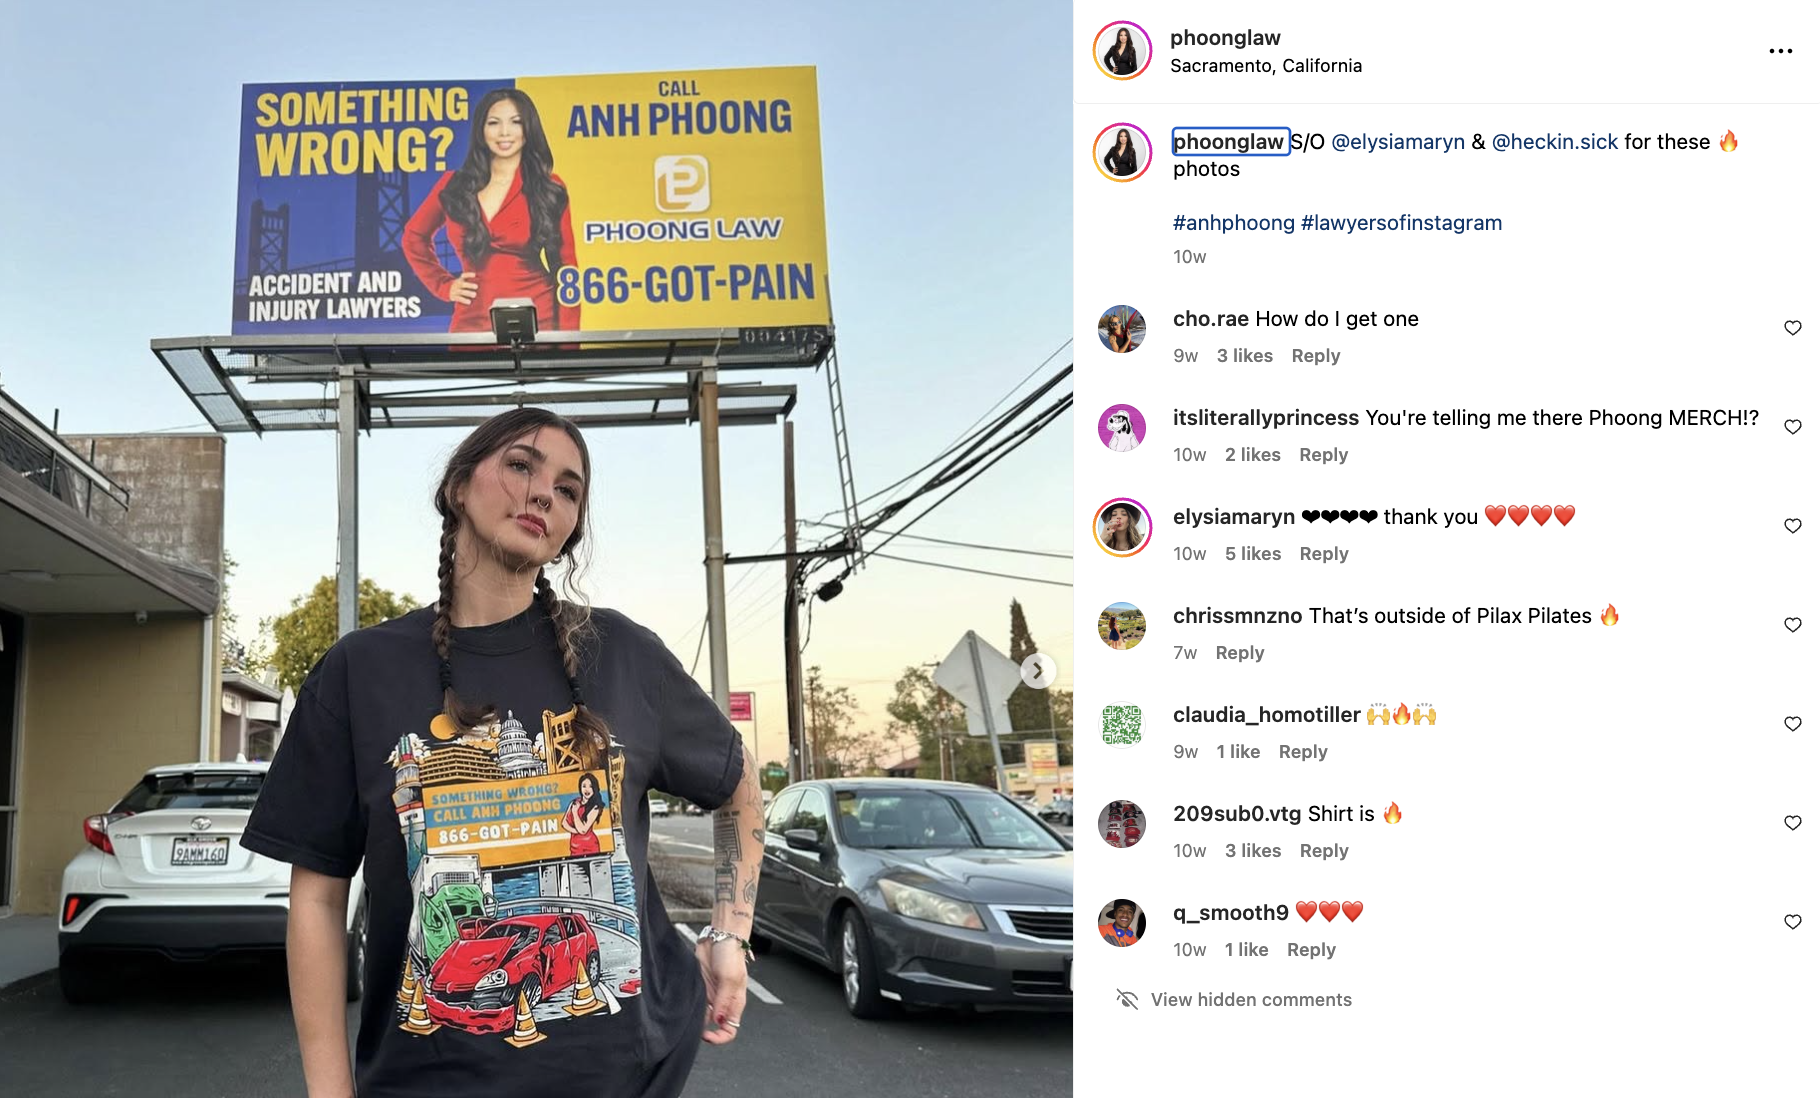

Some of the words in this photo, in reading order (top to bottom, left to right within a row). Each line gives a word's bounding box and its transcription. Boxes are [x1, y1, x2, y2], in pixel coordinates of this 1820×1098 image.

[658, 79, 701, 97] CALL
[255, 87, 470, 128] SOMETHING
[567, 103, 640, 138] ANH
[649, 99, 793, 136] PHOONG
[254, 127, 455, 177] WRONG?
[585, 220, 710, 242] PHOONG
[717, 218, 783, 239] LAW
[249, 271, 352, 296] ACCIDENT
[357, 270, 402, 292] AND
[558, 263, 816, 306] 866-GOT-PAIN
[249, 299, 321, 322] INJURY
[326, 296, 422, 319] LAWYERS
[431, 789, 503, 806] SOMETHING
[507, 783, 559, 800] WRONG?
[433, 810, 467, 823] CALL
[472, 806, 500, 819] ANH
[505, 799, 561, 816] PHOONG
[438, 818, 559, 845] 866-GOT-PAIN
